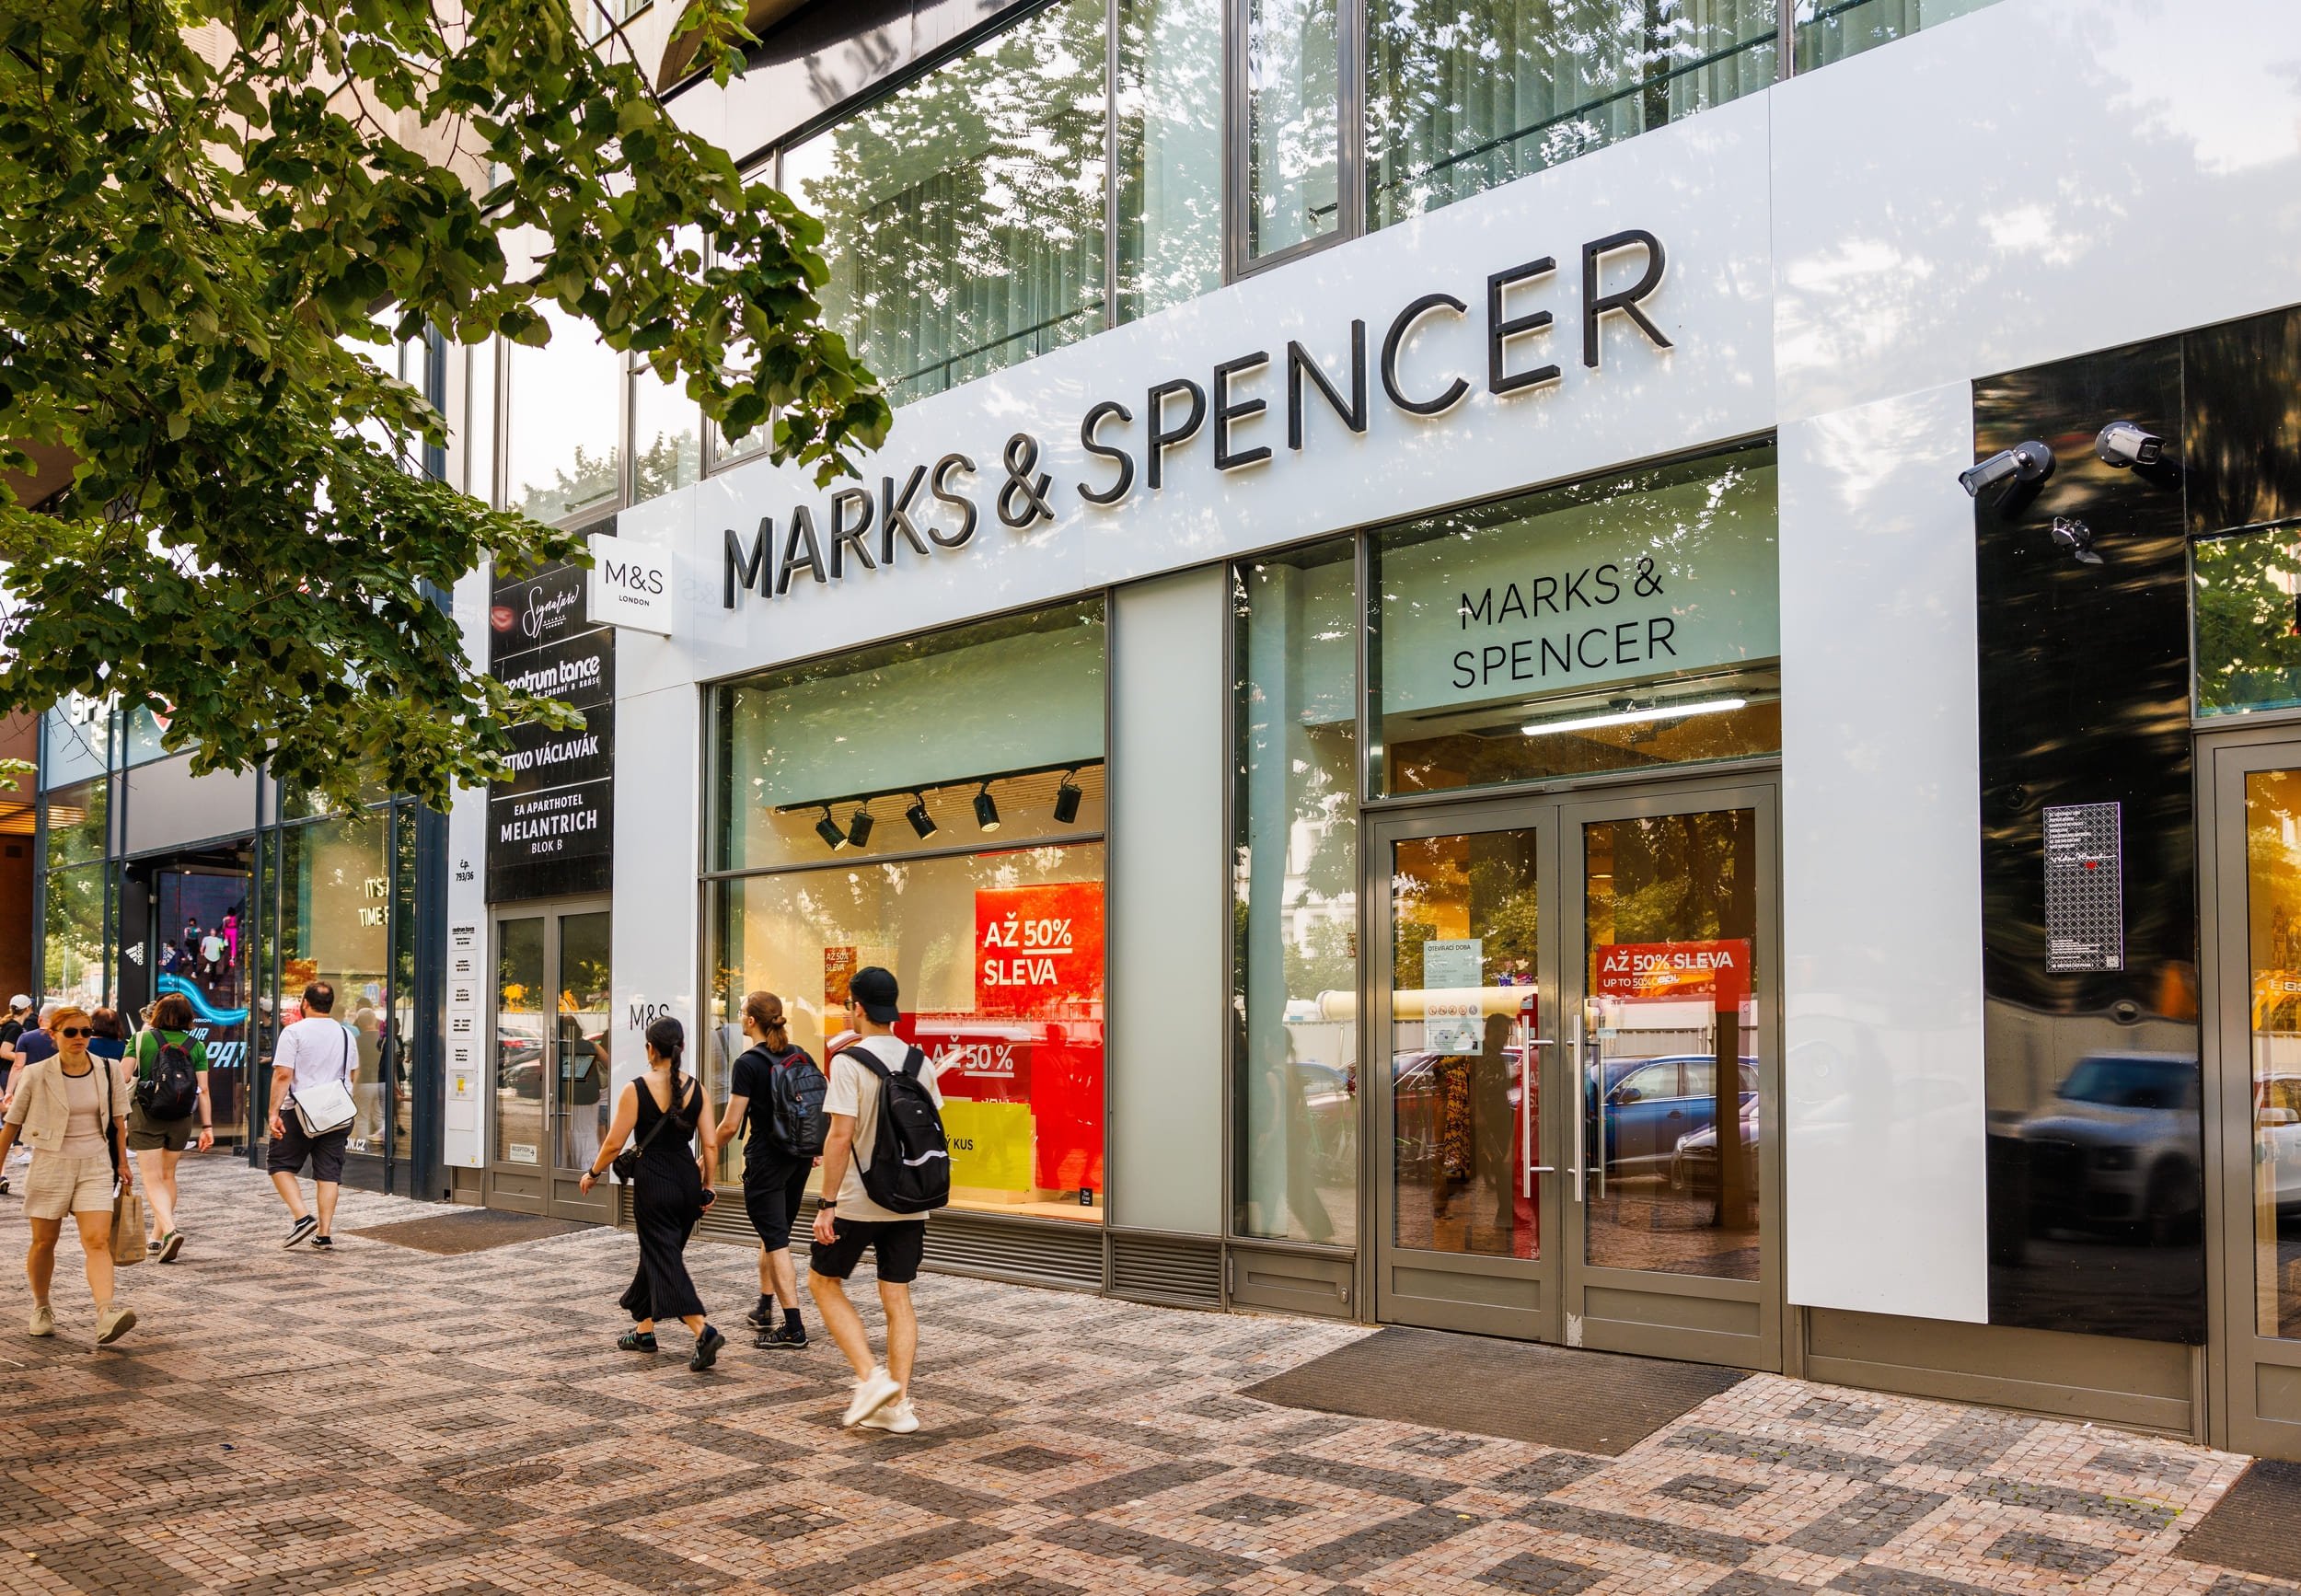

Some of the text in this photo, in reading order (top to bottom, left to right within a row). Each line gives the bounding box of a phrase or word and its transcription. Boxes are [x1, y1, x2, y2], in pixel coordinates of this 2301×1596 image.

[723, 229, 1673, 610] MARKS & SPENCER
[606, 559, 663, 595] M&S
[619, 595, 650, 607] LONDON
[1460, 557, 1664, 630] MARKS &
[522, 584, 580, 638] Signature
[1452, 617, 1677, 688] SPENCER
[560, 655, 600, 683] tance
[535, 732, 599, 767] VÁCLAVÁK
[514, 793, 584, 816] EA APARTHOTEL
[501, 809, 597, 843] MELANTRICH
[531, 838, 563, 854] BLOK B
[358, 906, 384, 928] TIME
[984, 910, 1072, 948] AŽ 50%
[983, 958, 1058, 986] SLEVA
[1603, 950, 1734, 972] AŽ 50% SLEVA
[1603, 979, 1617, 988] UP
[1618, 978, 1632, 987] TO
[1633, 978, 1652, 987] 50%
[954, 1139, 974, 1151] KUS
